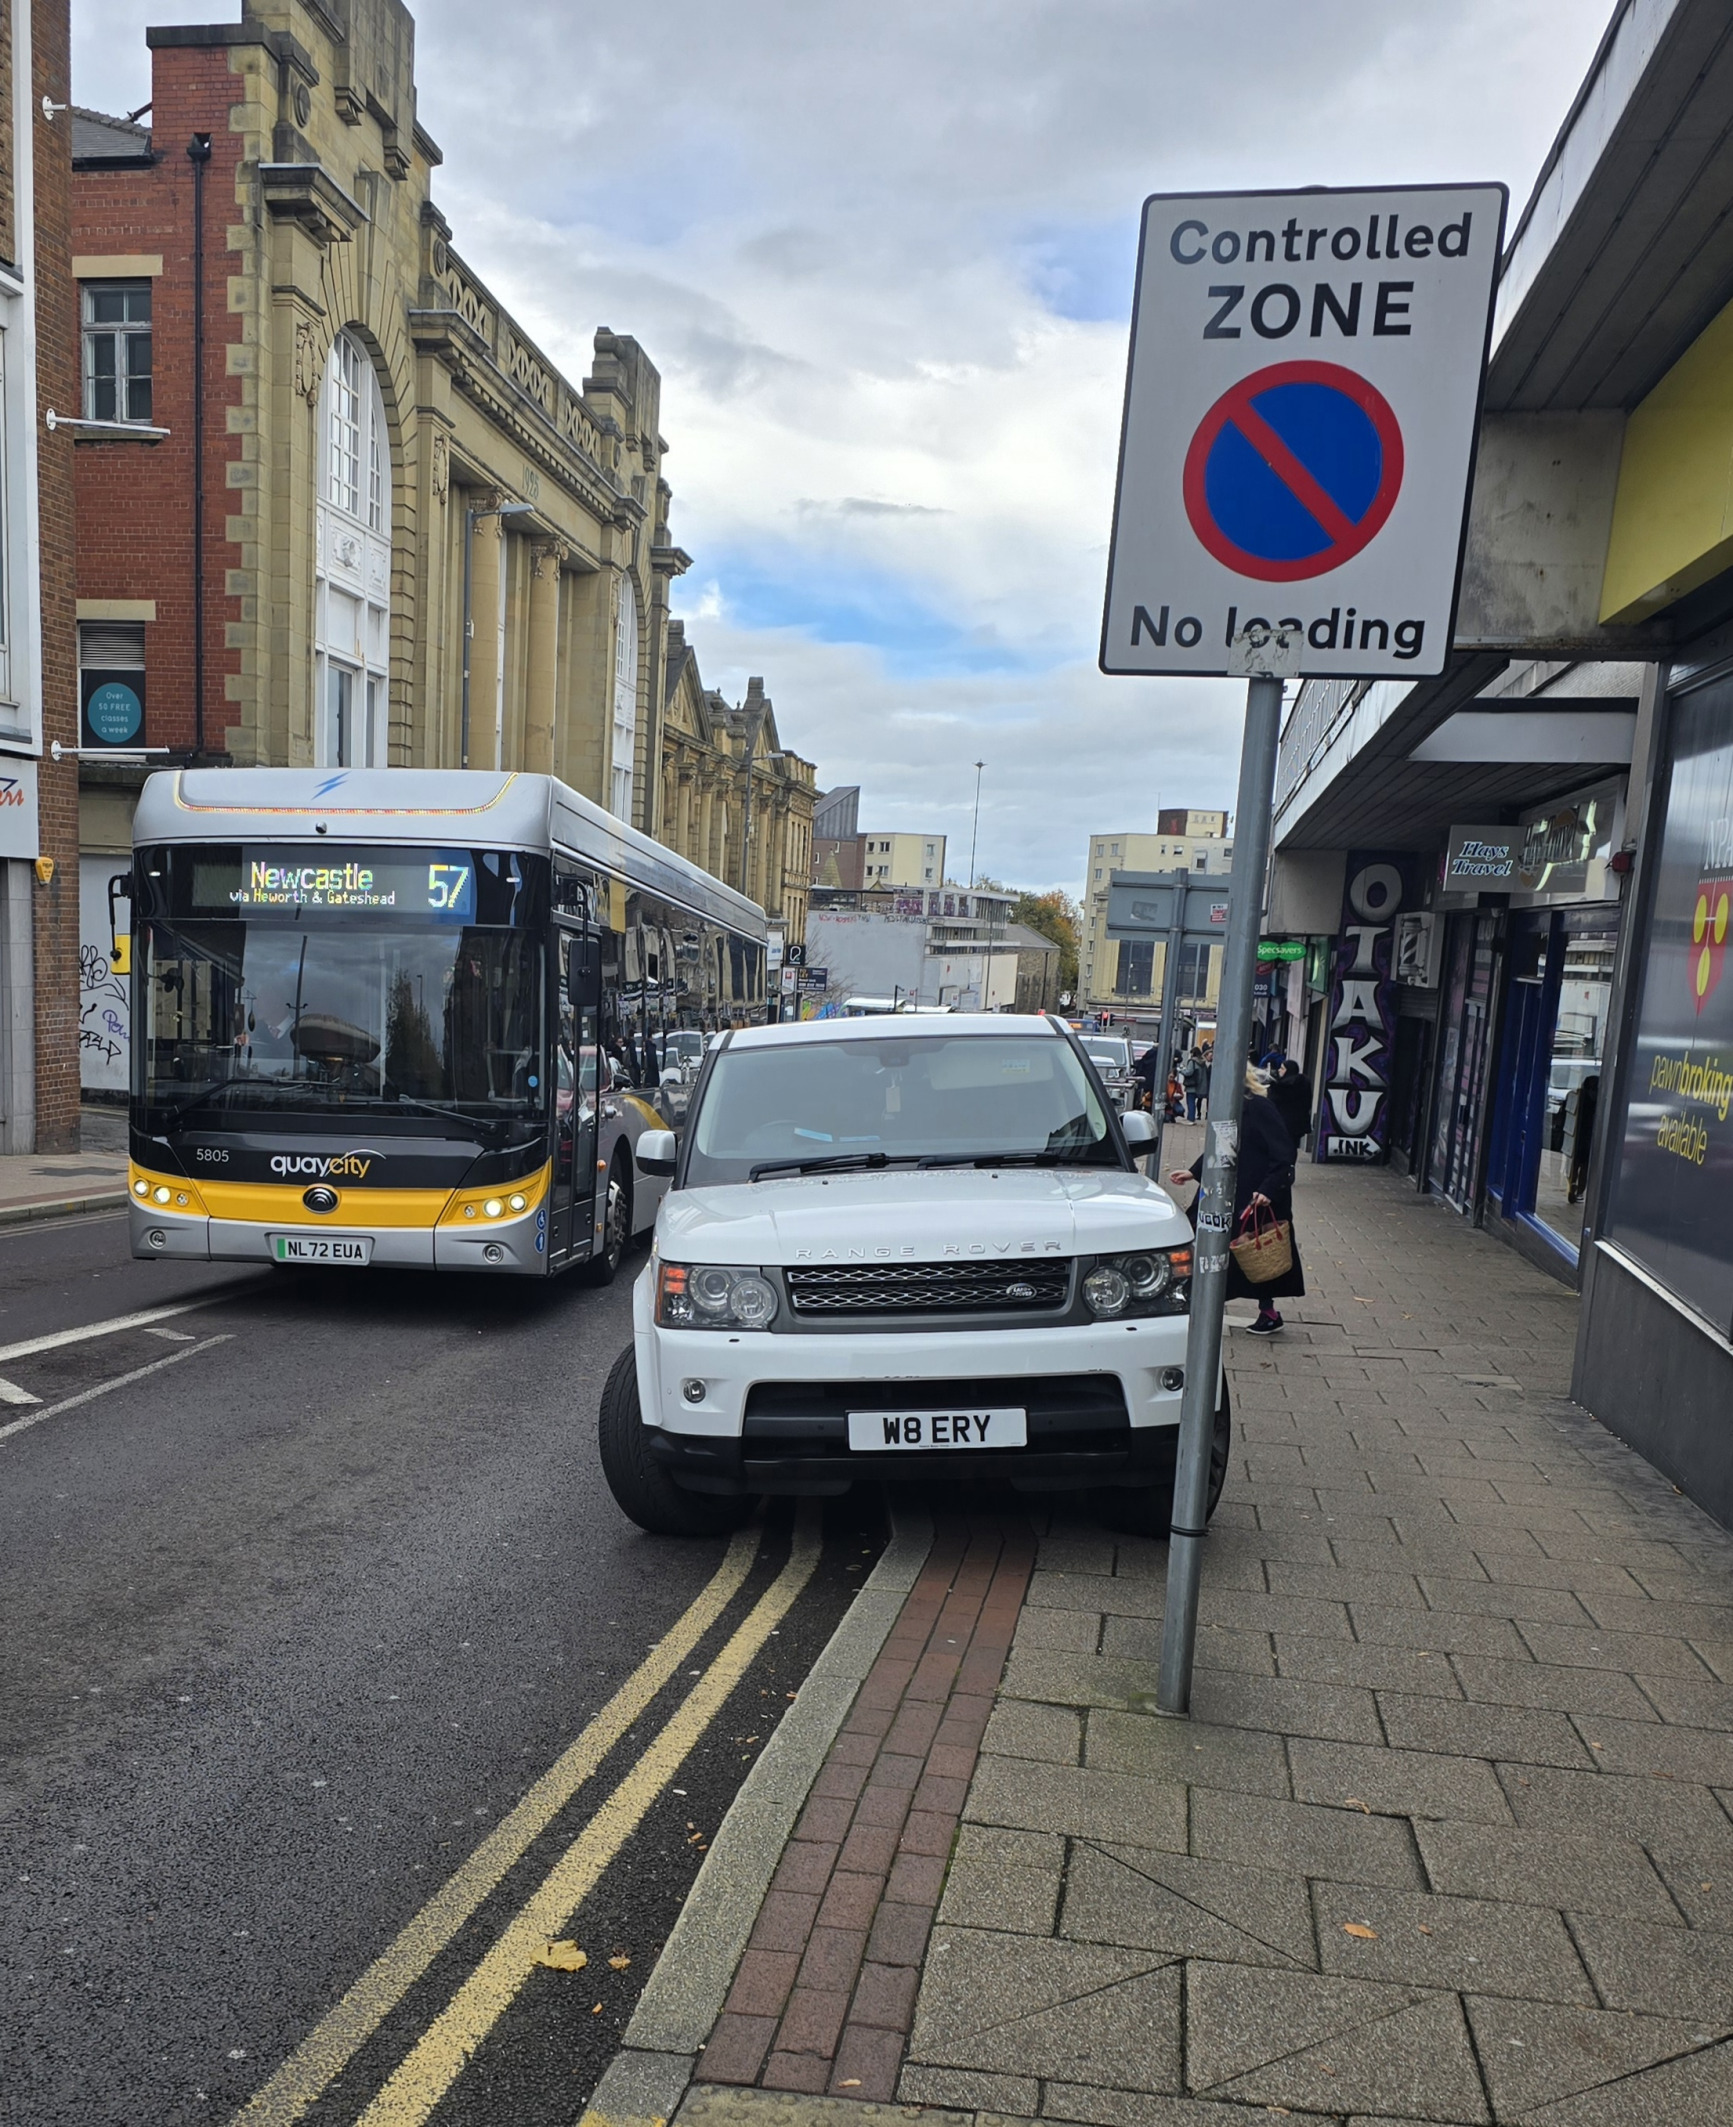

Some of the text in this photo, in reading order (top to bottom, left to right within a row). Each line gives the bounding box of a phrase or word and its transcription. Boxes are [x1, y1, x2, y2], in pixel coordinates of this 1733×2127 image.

[1169, 211, 1473, 266] Controlled
[1202, 281, 1416, 340] ZONE
[1129, 605, 1203, 648] No
[105, 691, 123, 700] Over
[98, 702, 130, 711] 50 FREE
[101, 714, 128, 722] classes
[108, 725, 128, 734] week
[1459, 841, 1509, 861] Hays
[1451, 859, 1514, 877] Travel
[251, 861, 469, 908] Newcastle 57
[229, 888, 395, 905] via Heworth & Gateshead
[1258, 945, 1302, 955] Specsavers
[1327, 862, 1403, 1135] OTAKU
[1650, 1051, 1732, 1122] pawnbroking
[1657, 1112, 1708, 1166] available
[196, 1149, 371, 1178] 5805 quaycity
[288, 1241, 363, 1259] NL72 EUA
[795, 1240, 1061, 1258] RANGE ROVER
[883, 1415, 991, 1444] W8 ERY
